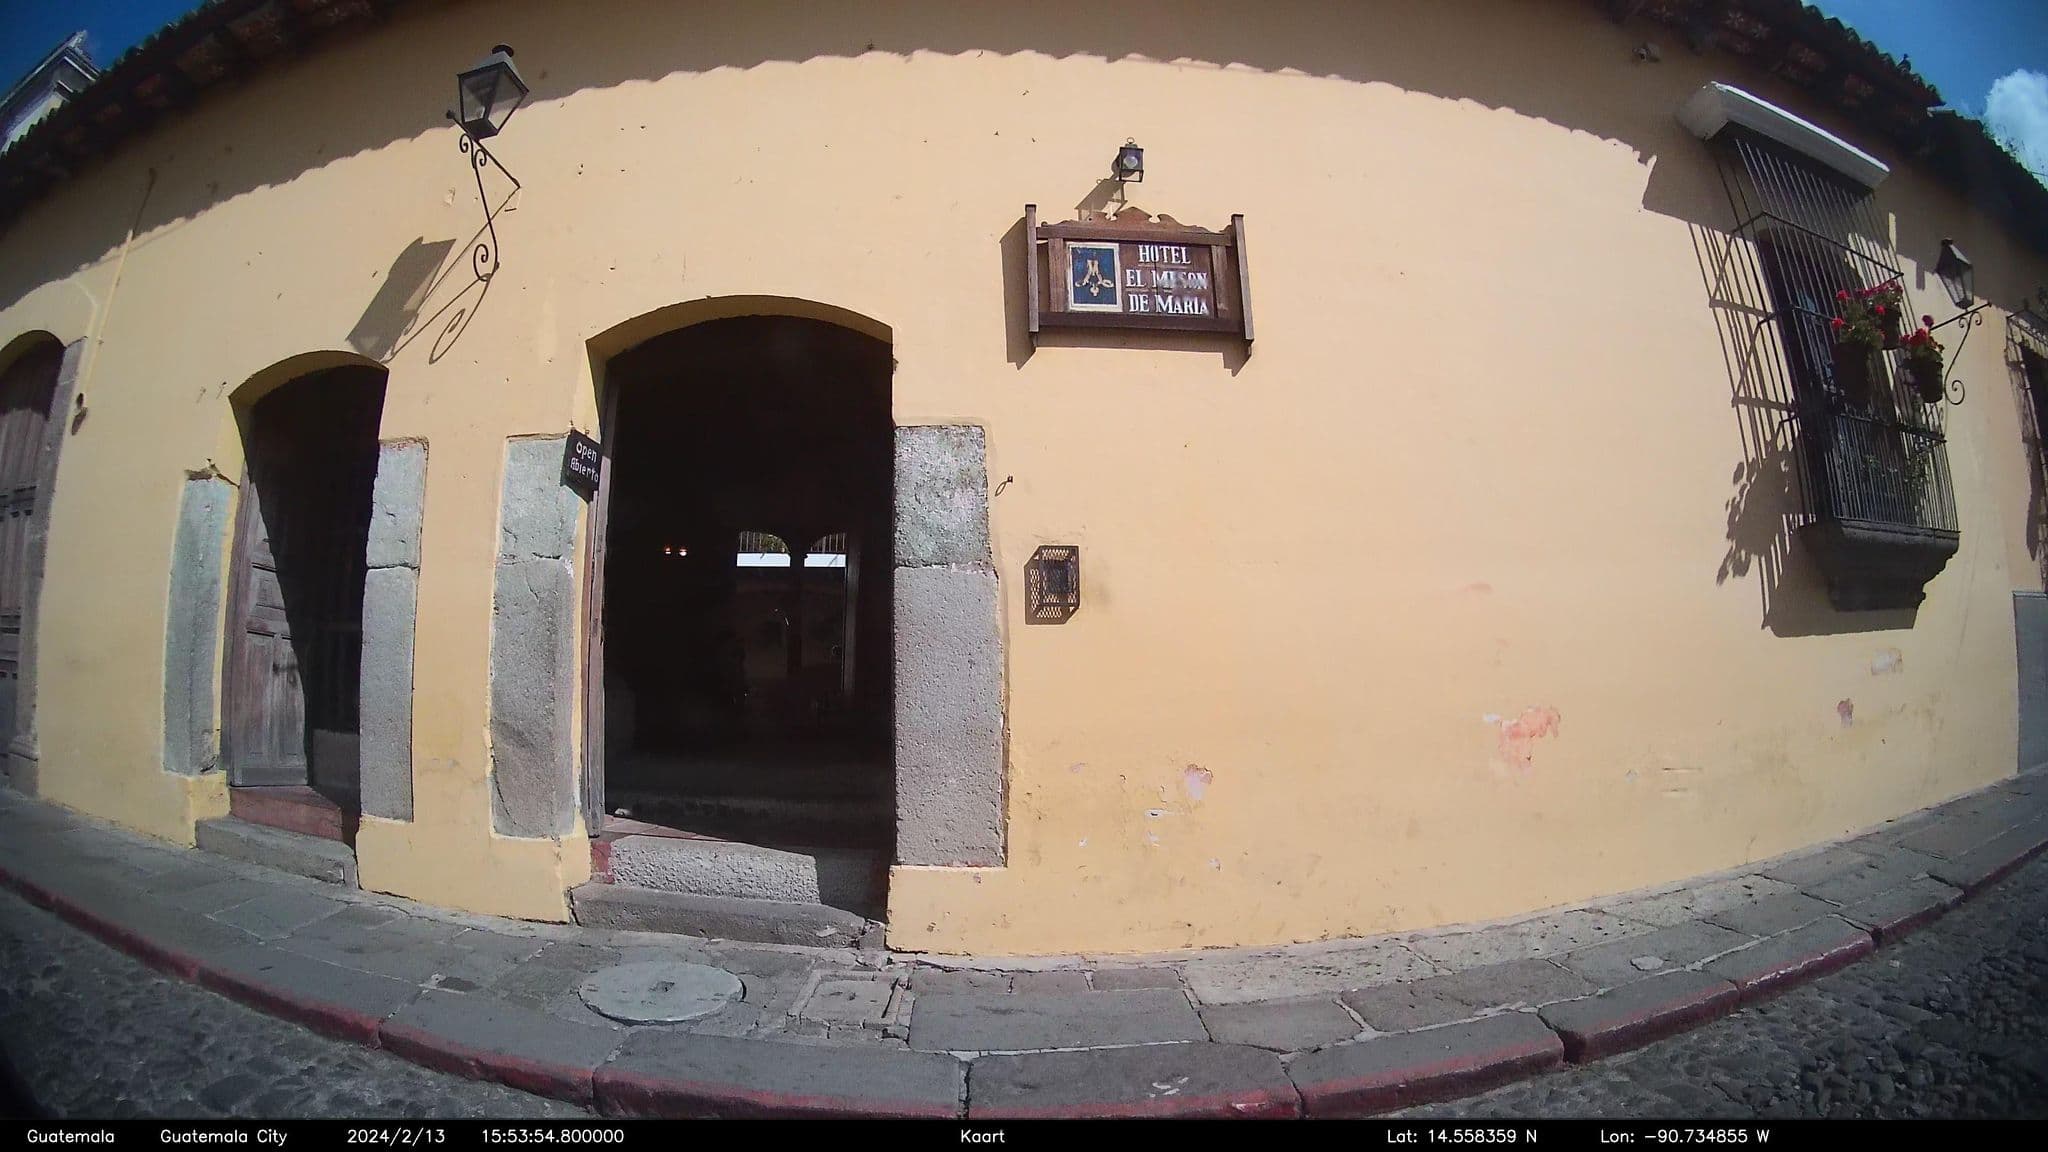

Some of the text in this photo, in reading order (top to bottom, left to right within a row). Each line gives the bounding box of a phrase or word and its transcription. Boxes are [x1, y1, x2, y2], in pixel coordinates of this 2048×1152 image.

[1138, 245, 1191, 264] HOTEL
[1125, 269, 1147, 288] EL
[1128, 294, 1149, 312] DE
[576, 441, 597, 463] Open
